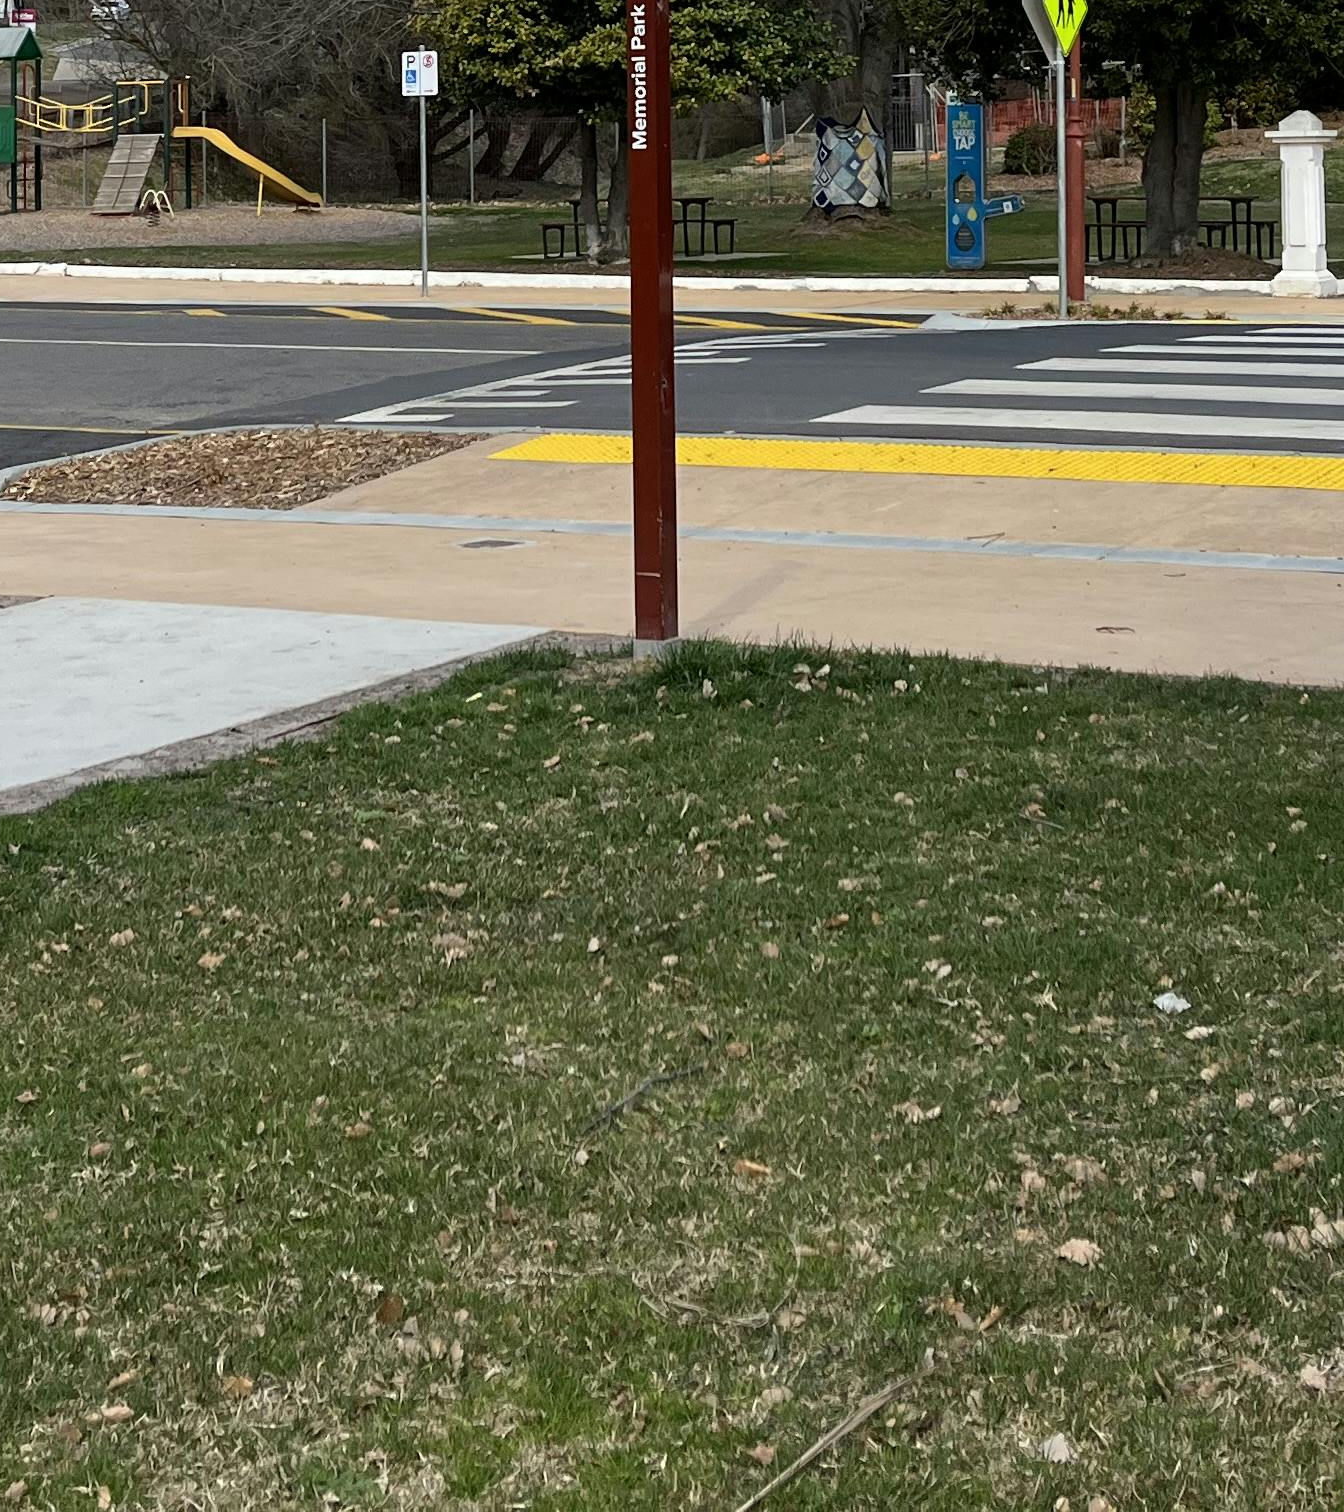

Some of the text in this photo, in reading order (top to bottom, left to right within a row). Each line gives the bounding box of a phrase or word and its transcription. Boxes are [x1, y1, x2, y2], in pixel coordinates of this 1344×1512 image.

[406, 55, 416, 69] P
[630, 3, 647, 150] Memorial Park
[954, 136, 975, 150] TAP
